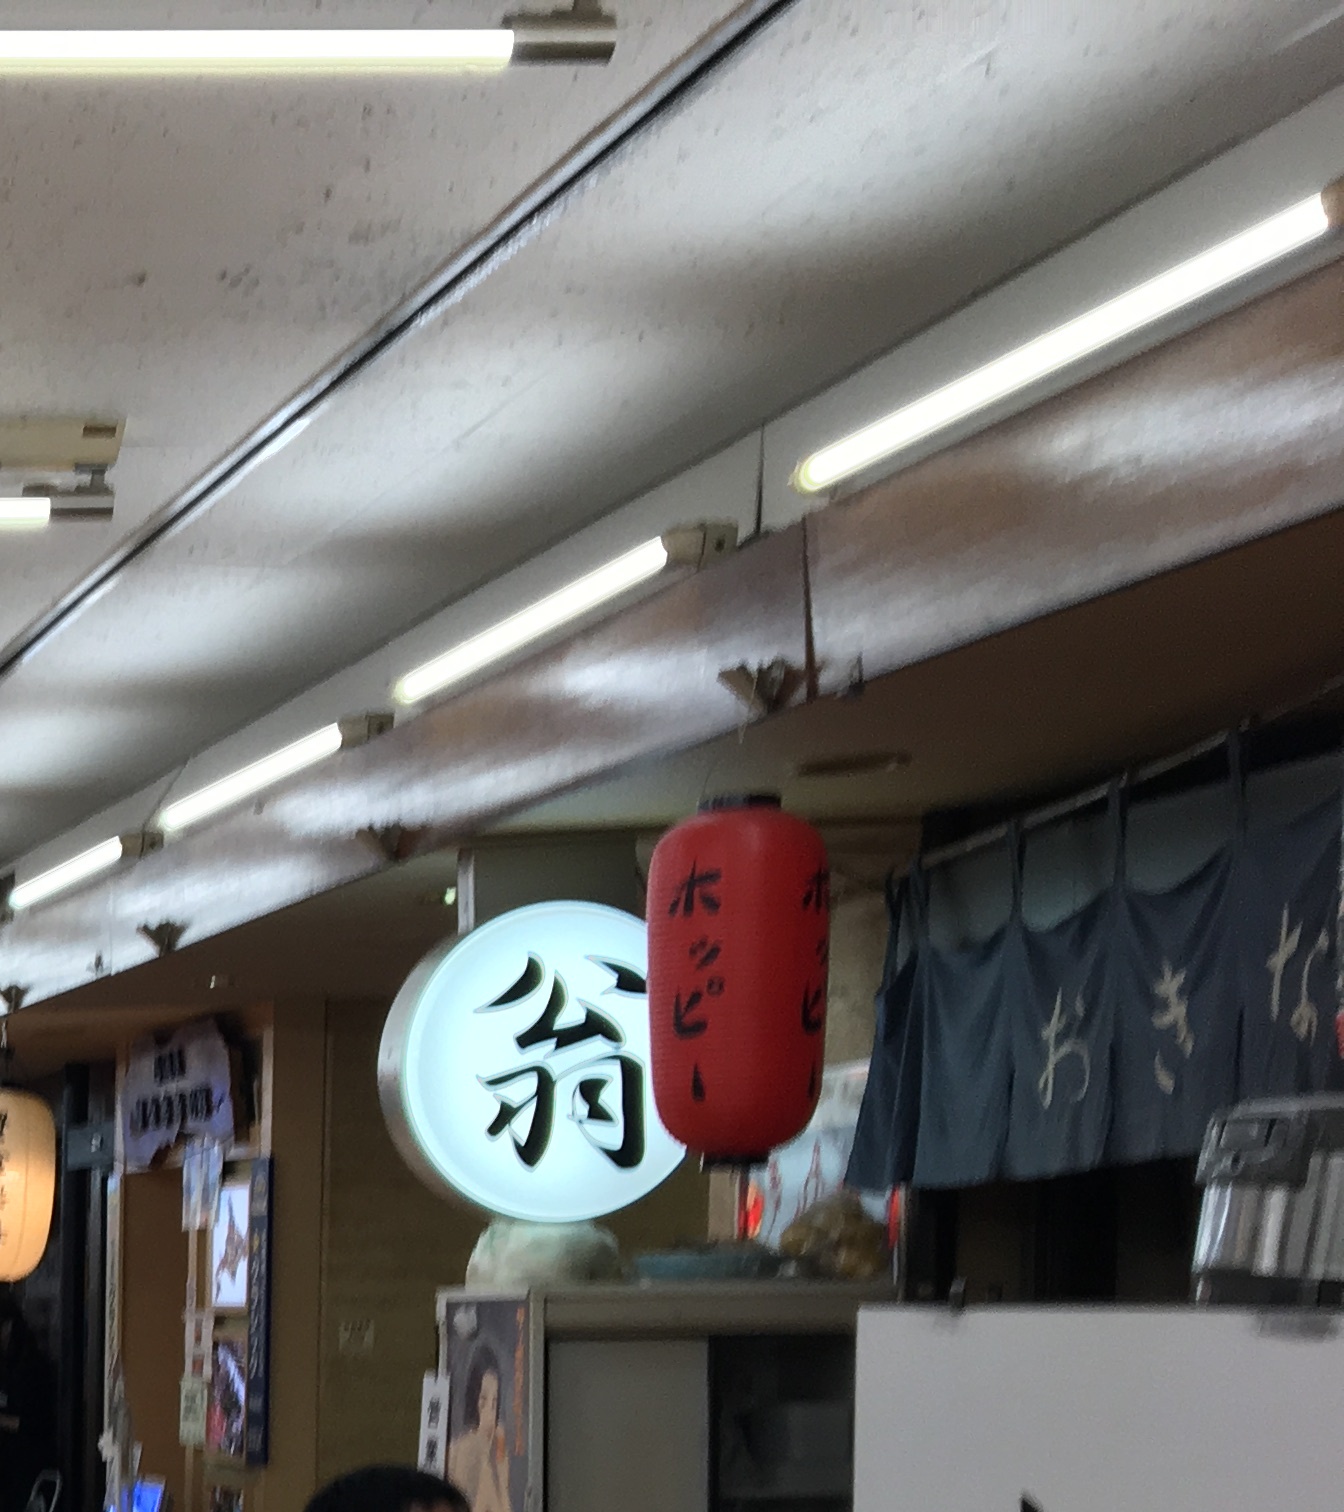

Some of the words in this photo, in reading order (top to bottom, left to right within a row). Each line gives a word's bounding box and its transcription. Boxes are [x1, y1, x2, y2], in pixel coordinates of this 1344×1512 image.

[473, 951, 648, 1174] 翁
[668, 855, 725, 1103] ホッピー
